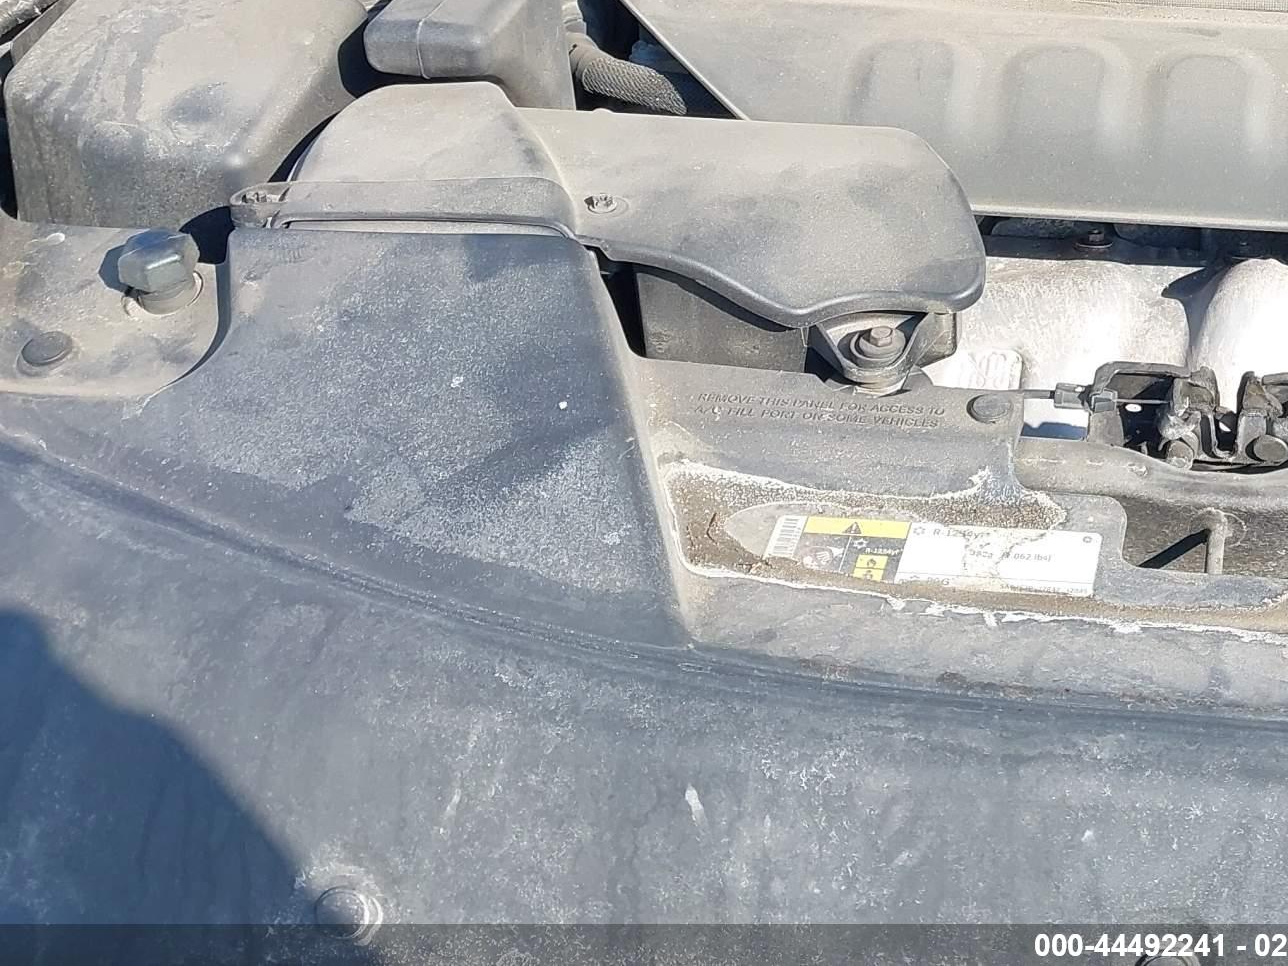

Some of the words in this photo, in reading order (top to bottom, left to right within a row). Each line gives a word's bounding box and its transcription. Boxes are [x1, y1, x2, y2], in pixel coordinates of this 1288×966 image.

[698, 393, 754, 404] REMOVE
[759, 396, 789, 407] THIS
[792, 399, 835, 410] PANEL
[839, 402, 867, 412] FOR
[870, 403, 924, 415] ACCESS
[929, 406, 945, 416] TO
[694, 405, 720, 416] A/C
[727, 407, 755, 417] FILL
[761, 409, 795, 419] PORT
[802, 411, 822, 421] ON
[823, 412, 866, 424] SOME
[873, 415, 939, 428] VEHICLES
